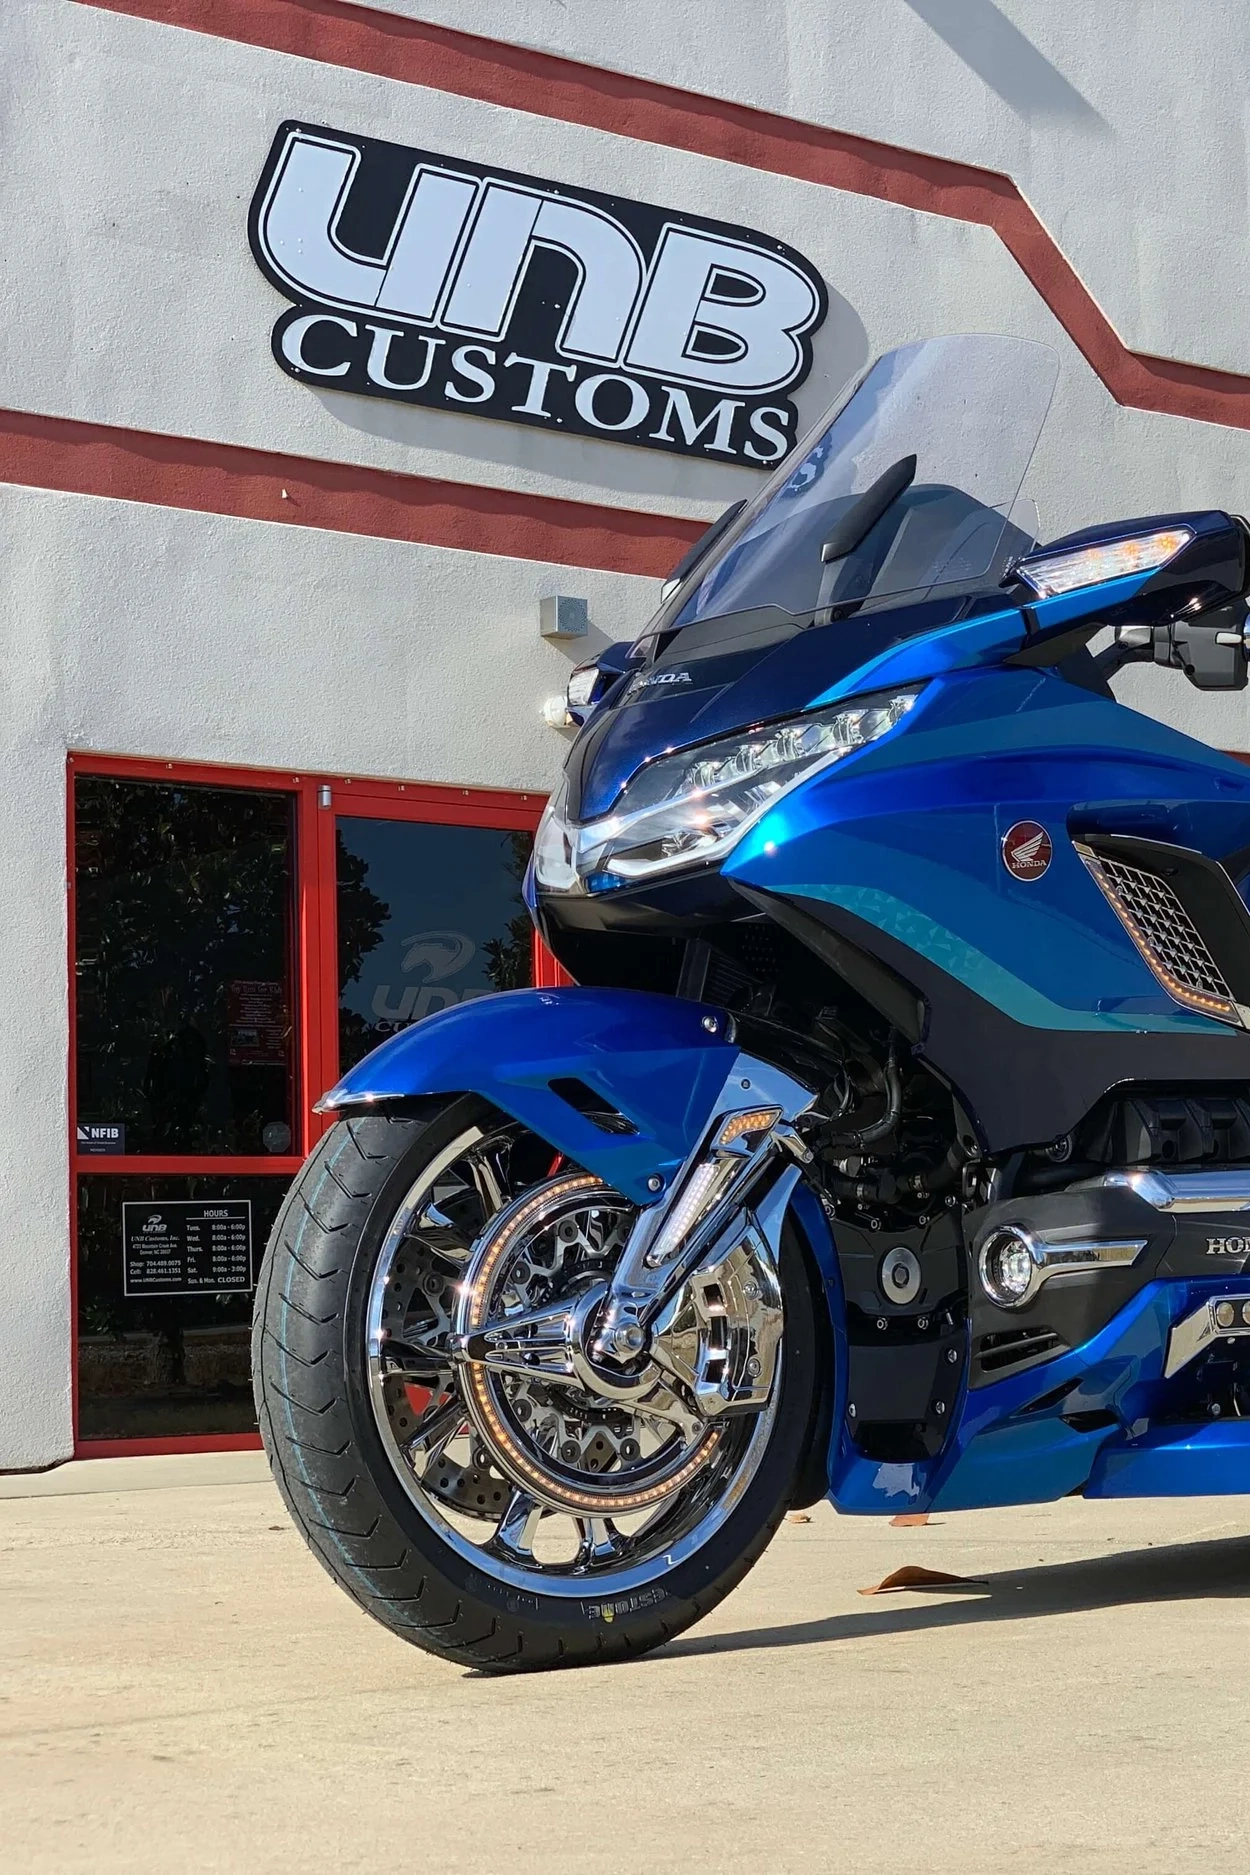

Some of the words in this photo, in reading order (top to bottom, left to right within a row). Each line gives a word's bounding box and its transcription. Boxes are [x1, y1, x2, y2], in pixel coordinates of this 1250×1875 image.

[281, 314, 789, 461] CUSTOMS
[1011, 859, 1047, 869] HONDA
[91, 1128, 119, 1138] NFIB
